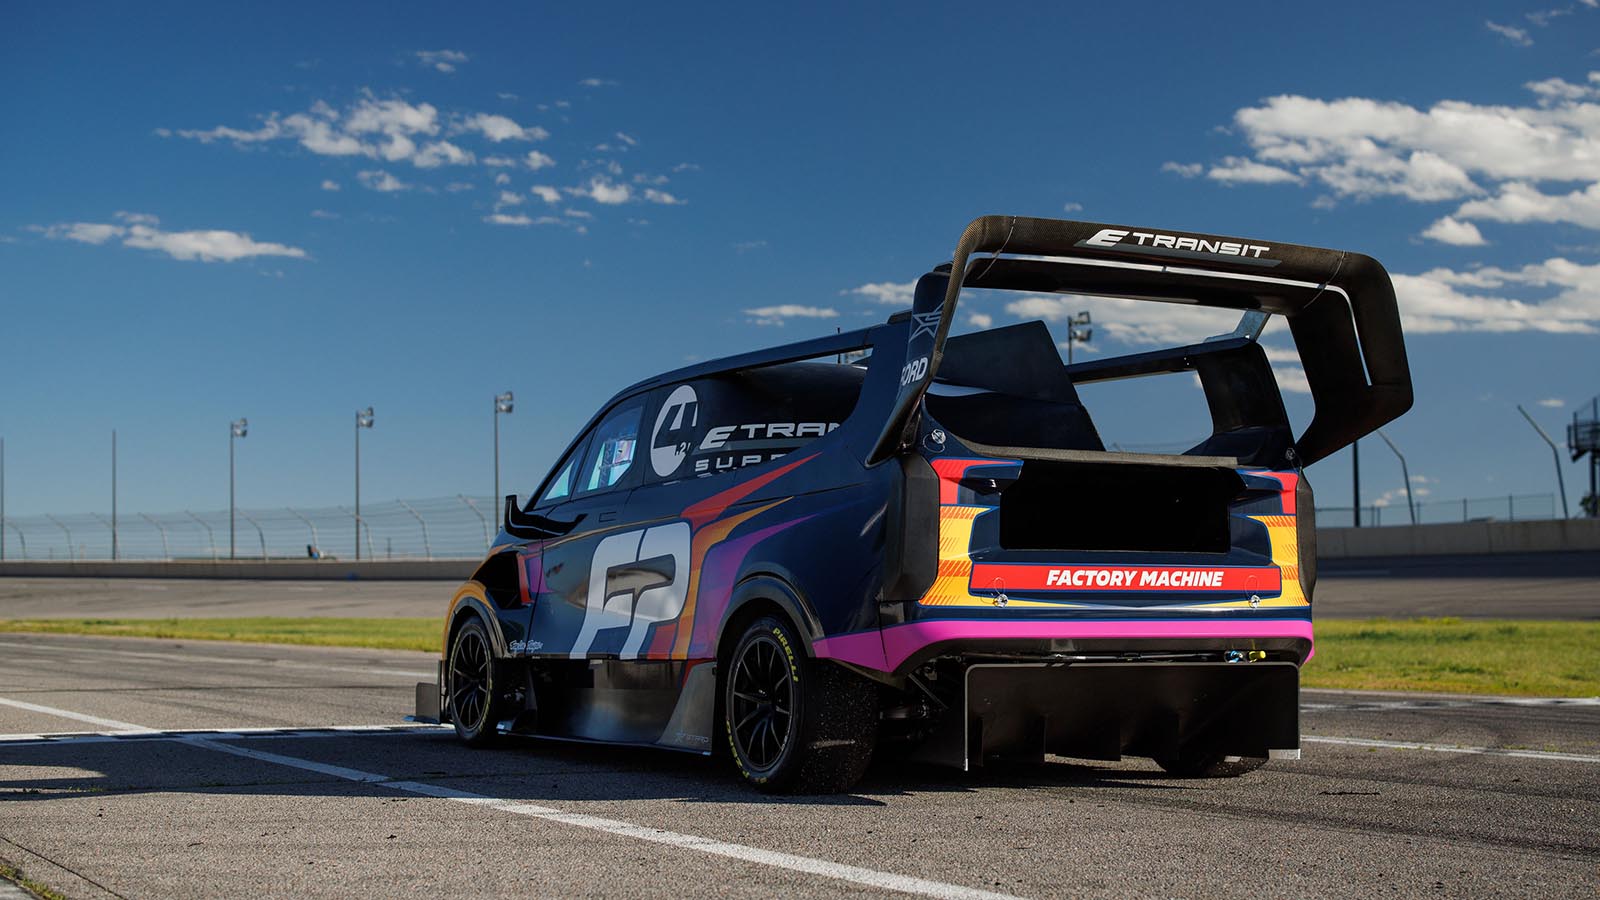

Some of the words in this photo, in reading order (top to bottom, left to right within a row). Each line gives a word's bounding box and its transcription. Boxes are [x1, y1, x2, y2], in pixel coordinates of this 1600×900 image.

[740, 422, 842, 438] TRA
[694, 453, 787, 472] SUP
[1046, 569, 1138, 587] FACTORY
[1139, 570, 1225, 587] MACHINE
[772, 627, 799, 683] PIRELLI
